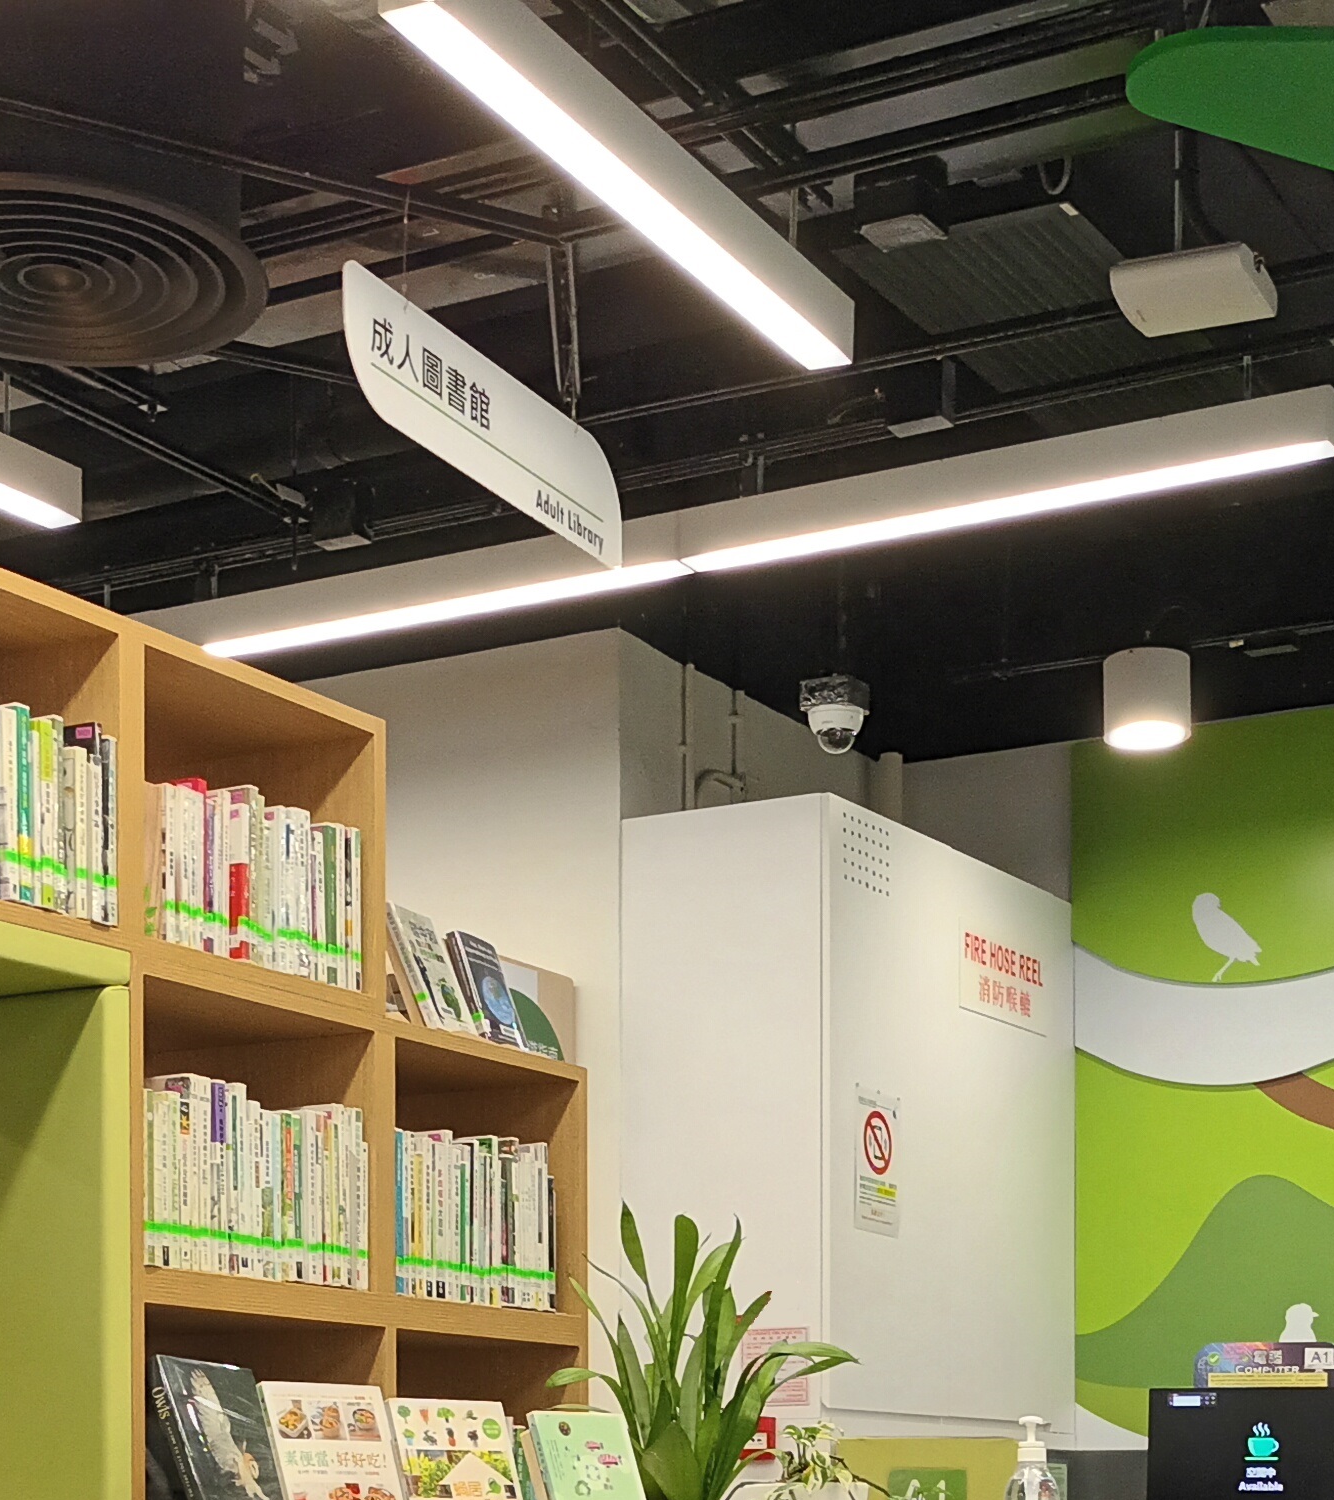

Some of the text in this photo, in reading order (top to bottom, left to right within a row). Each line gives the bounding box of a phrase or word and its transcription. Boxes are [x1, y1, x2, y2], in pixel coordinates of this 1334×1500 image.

[370, 316, 493, 432] 成人圖書館
[534, 488, 605, 555] Adult Library
[964, 931, 1044, 988] FIRE HOSE REEL
[1234, 1364, 1301, 1374] COMPUTER
[1310, 1351, 1329, 1364] A1
[151, 1385, 172, 1421] Owls
[1237, 1480, 1285, 1492] Available
